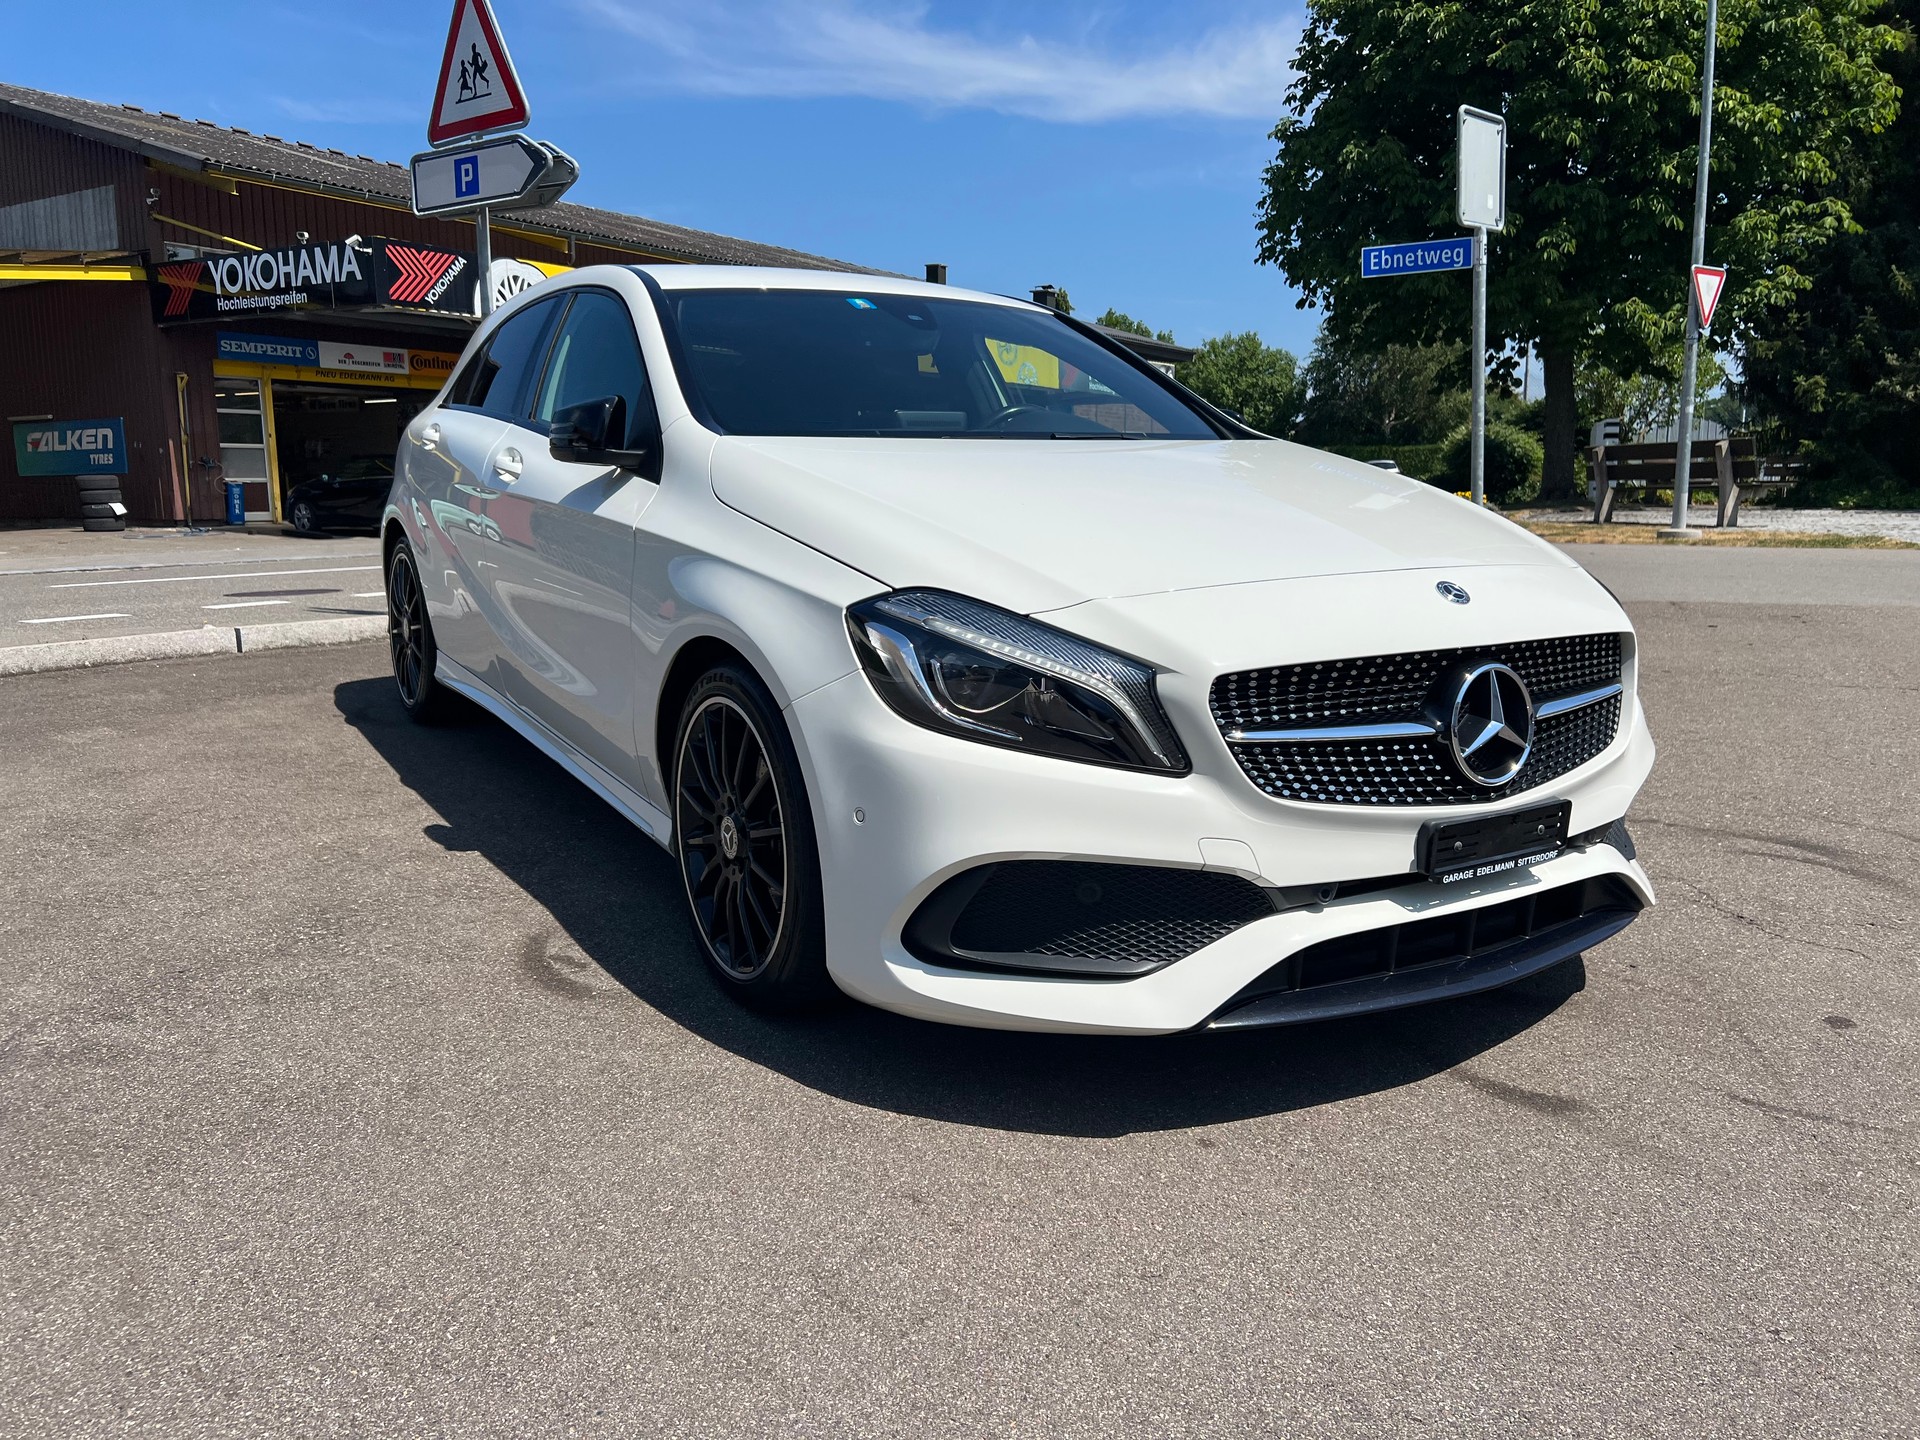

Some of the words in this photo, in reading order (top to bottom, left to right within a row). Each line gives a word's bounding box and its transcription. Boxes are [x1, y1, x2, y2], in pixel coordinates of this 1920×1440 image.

[461, 163, 473, 192] P
[207, 245, 363, 295] YOKOHAMA
[1370, 247, 1464, 270] Ebnetweg
[424, 255, 468, 305] YOKOHAMA
[216, 291, 308, 311] Hochleistungsreifen
[220, 339, 303, 358] SEMPERIT
[410, 354, 458, 371] Contine
[315, 370, 337, 379] PNEU
[339, 372, 382, 382] EDELMANN
[384, 375, 395, 383] AG
[27, 428, 114, 452] FALKEN
[89, 453, 114, 465] TYRES
[1442, 869, 1474, 884] GARAGE
[1476, 860, 1515, 877] EDELMANN
[1517, 850, 1559, 867] SITTERDORF
